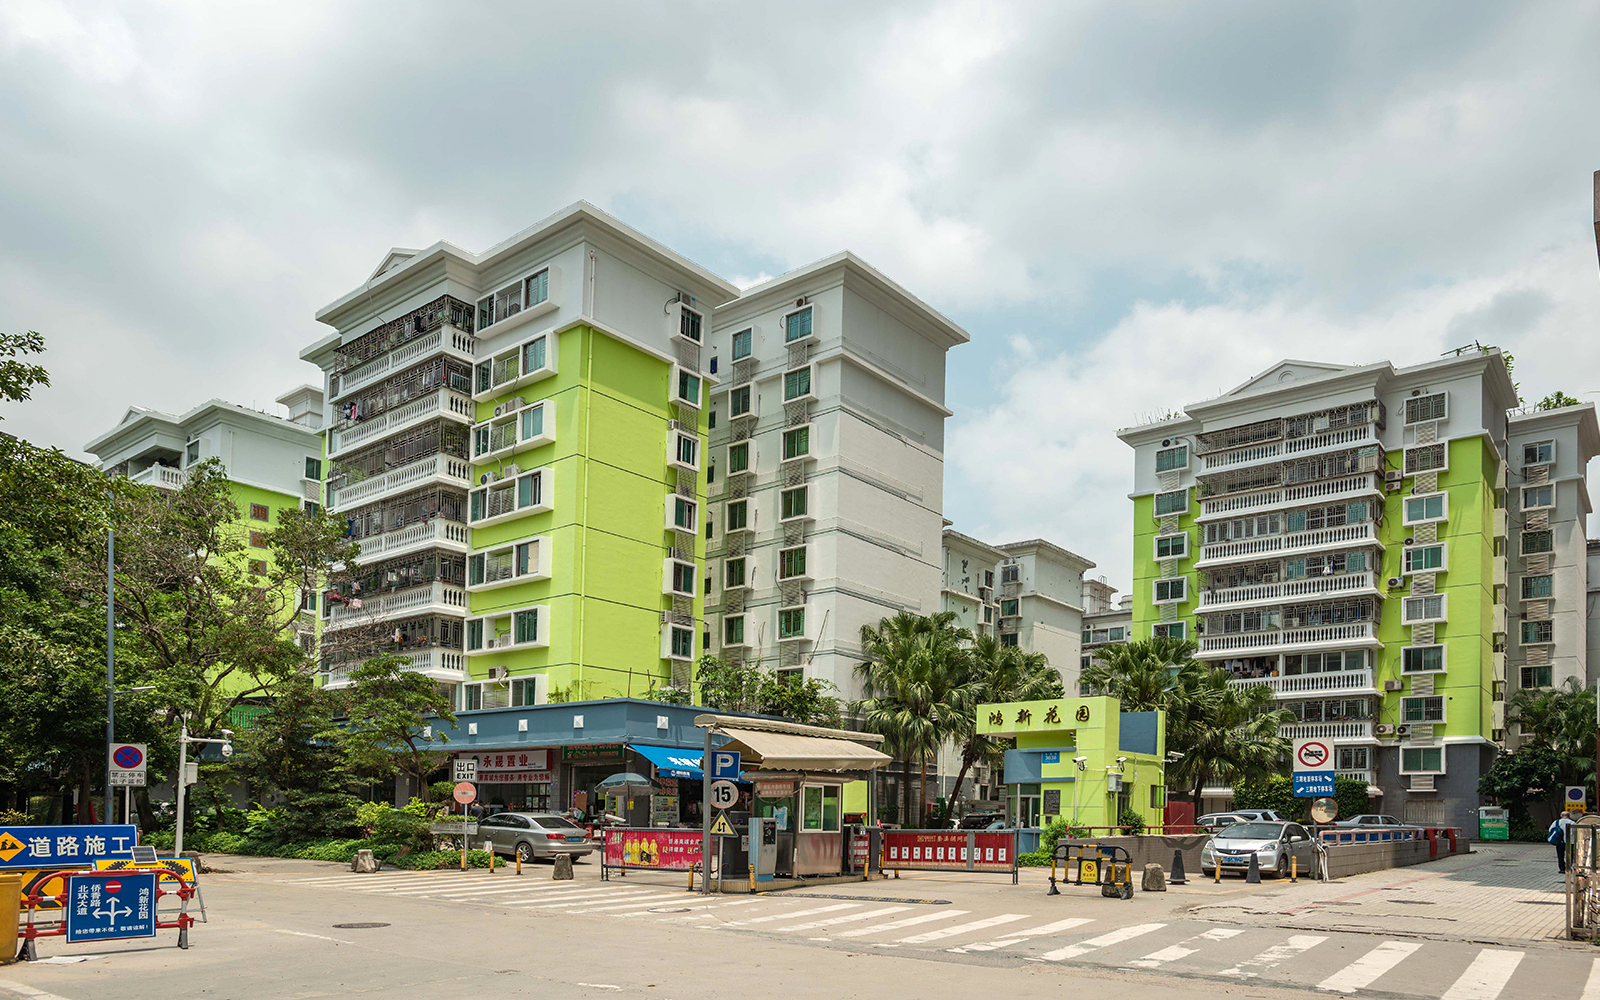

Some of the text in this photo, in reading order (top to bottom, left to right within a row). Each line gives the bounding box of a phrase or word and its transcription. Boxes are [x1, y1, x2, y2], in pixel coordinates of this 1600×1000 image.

[988, 705, 1090, 726] 鸿新花园
[456, 762, 475, 772] 出口
[715, 754, 734, 776] P
[714, 786, 731, 803] 15
[28, 835, 132, 857] 道路施工
[76, 884, 89, 916] 北环大道
[89, 883, 101, 907] 侨香路
[138, 887, 149, 920] 鸿新花园
